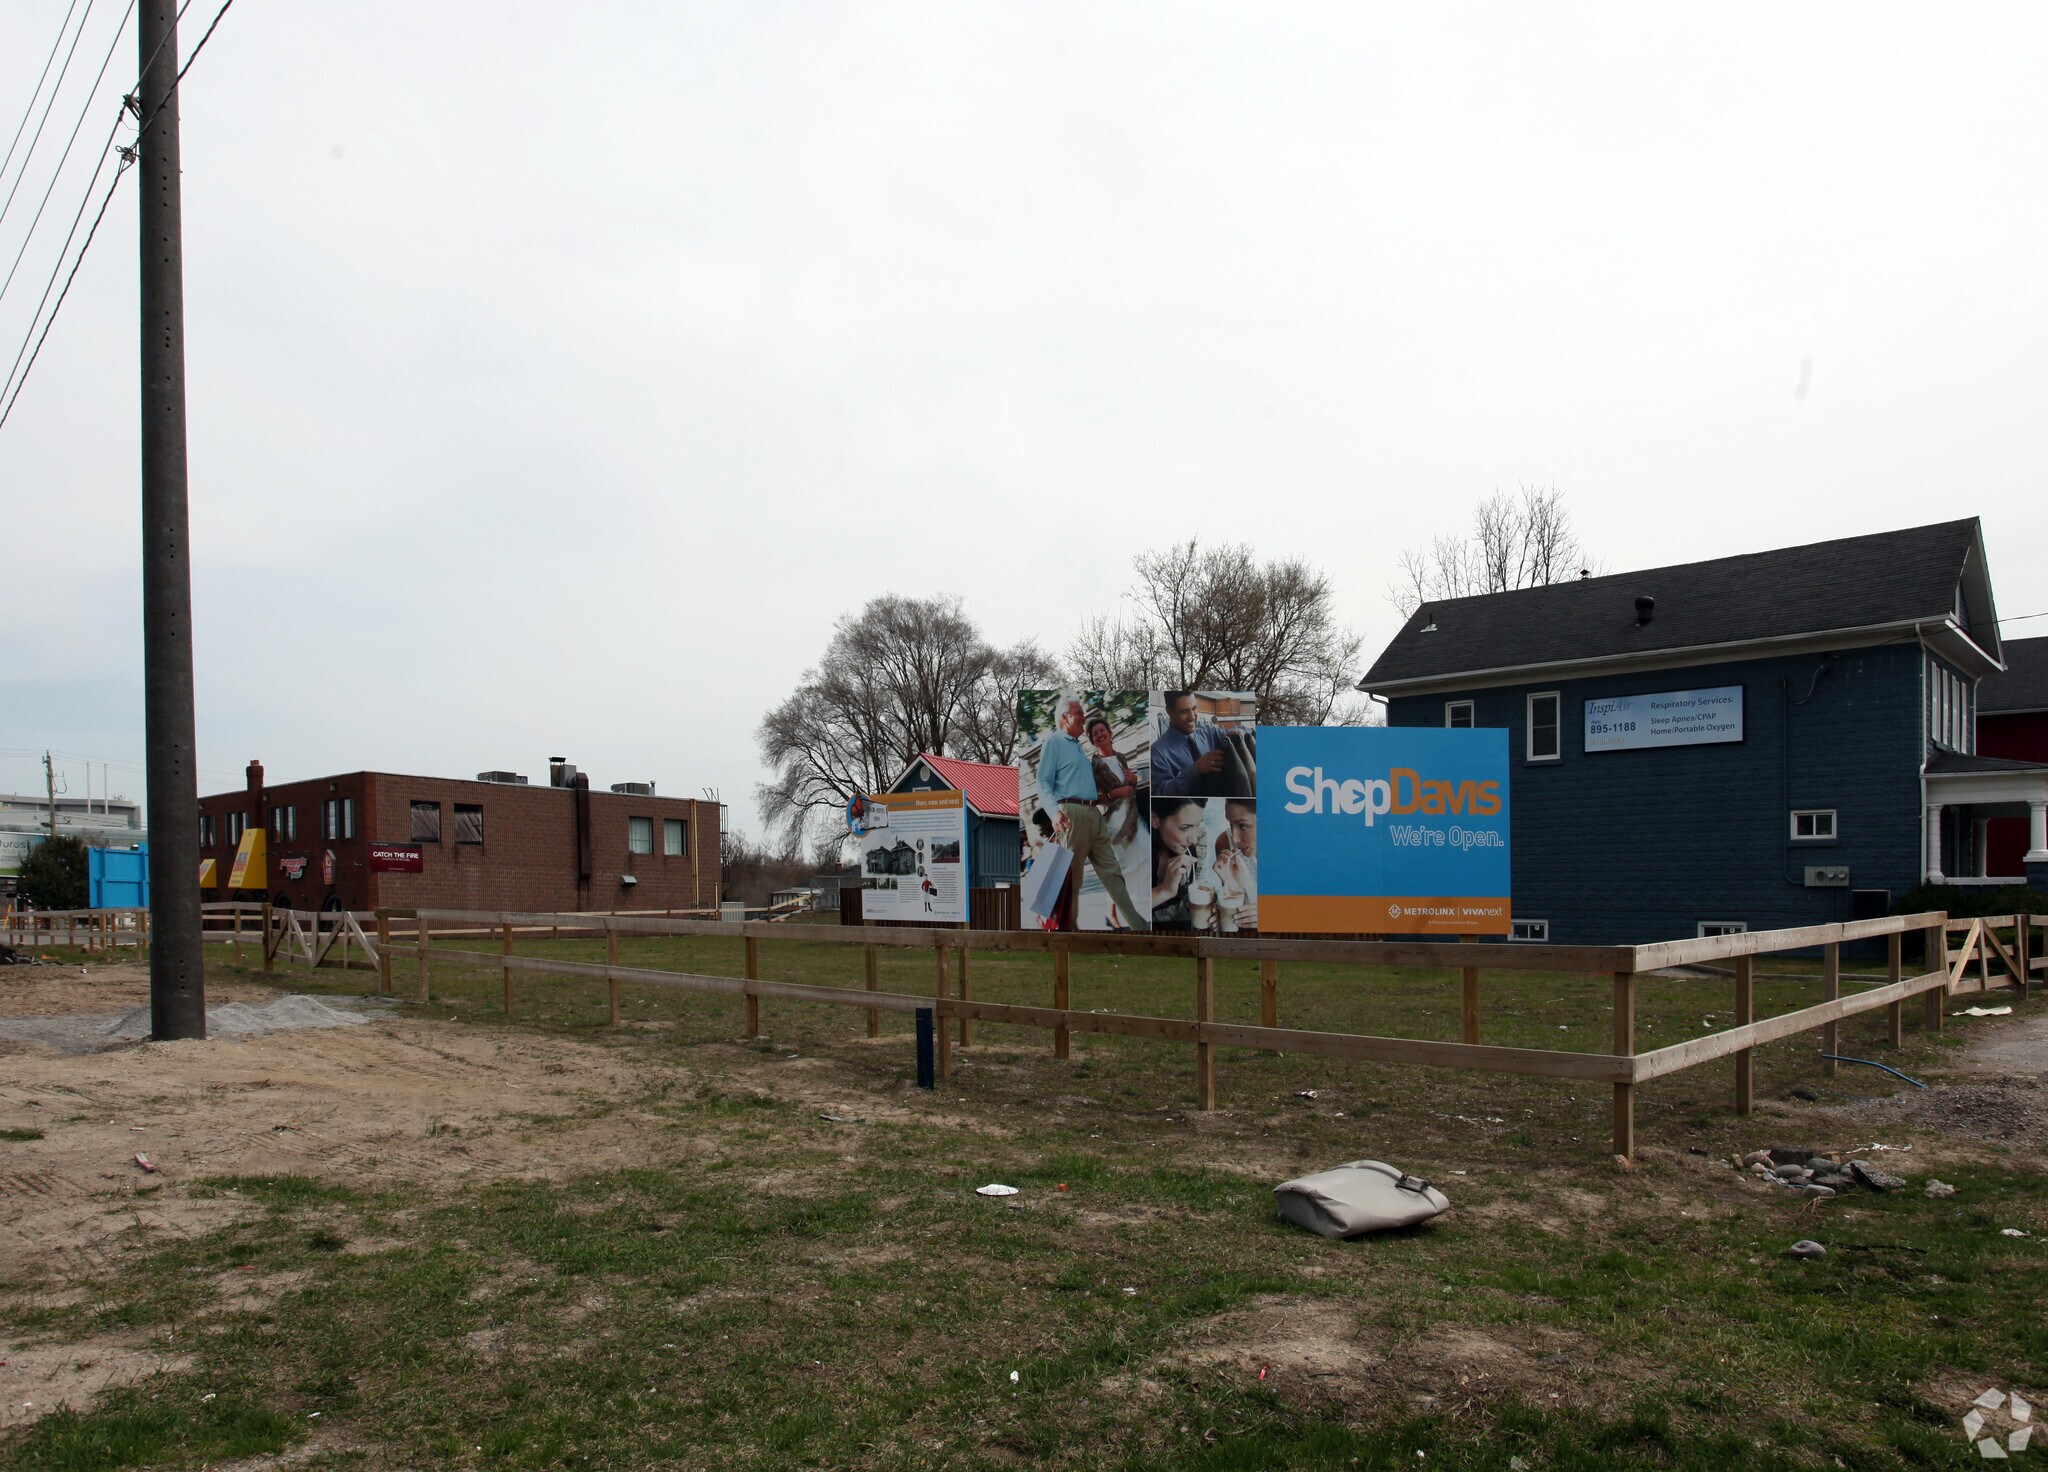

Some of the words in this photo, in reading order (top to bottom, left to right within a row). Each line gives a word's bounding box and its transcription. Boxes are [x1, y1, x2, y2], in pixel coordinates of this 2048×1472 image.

[1588, 699, 1632, 715] InspiAir
[1650, 700, 1696, 711] Respiratory
[1698, 696, 1734, 706] Services:
[1650, 716, 1670, 725] Sleep
[1671, 713, 1717, 724] Apnea/CPAP
[1590, 722, 1636, 734] 895-1188
[1650, 724, 1705, 735] Home/Portable
[1706, 723, 1735, 733] Oxygen
[915, 799, 928, 807] then,
[1390, 826, 1445, 846] We're
[1449, 826, 1504, 851] Open.
[1404, 907, 1455, 916] METROLINX
